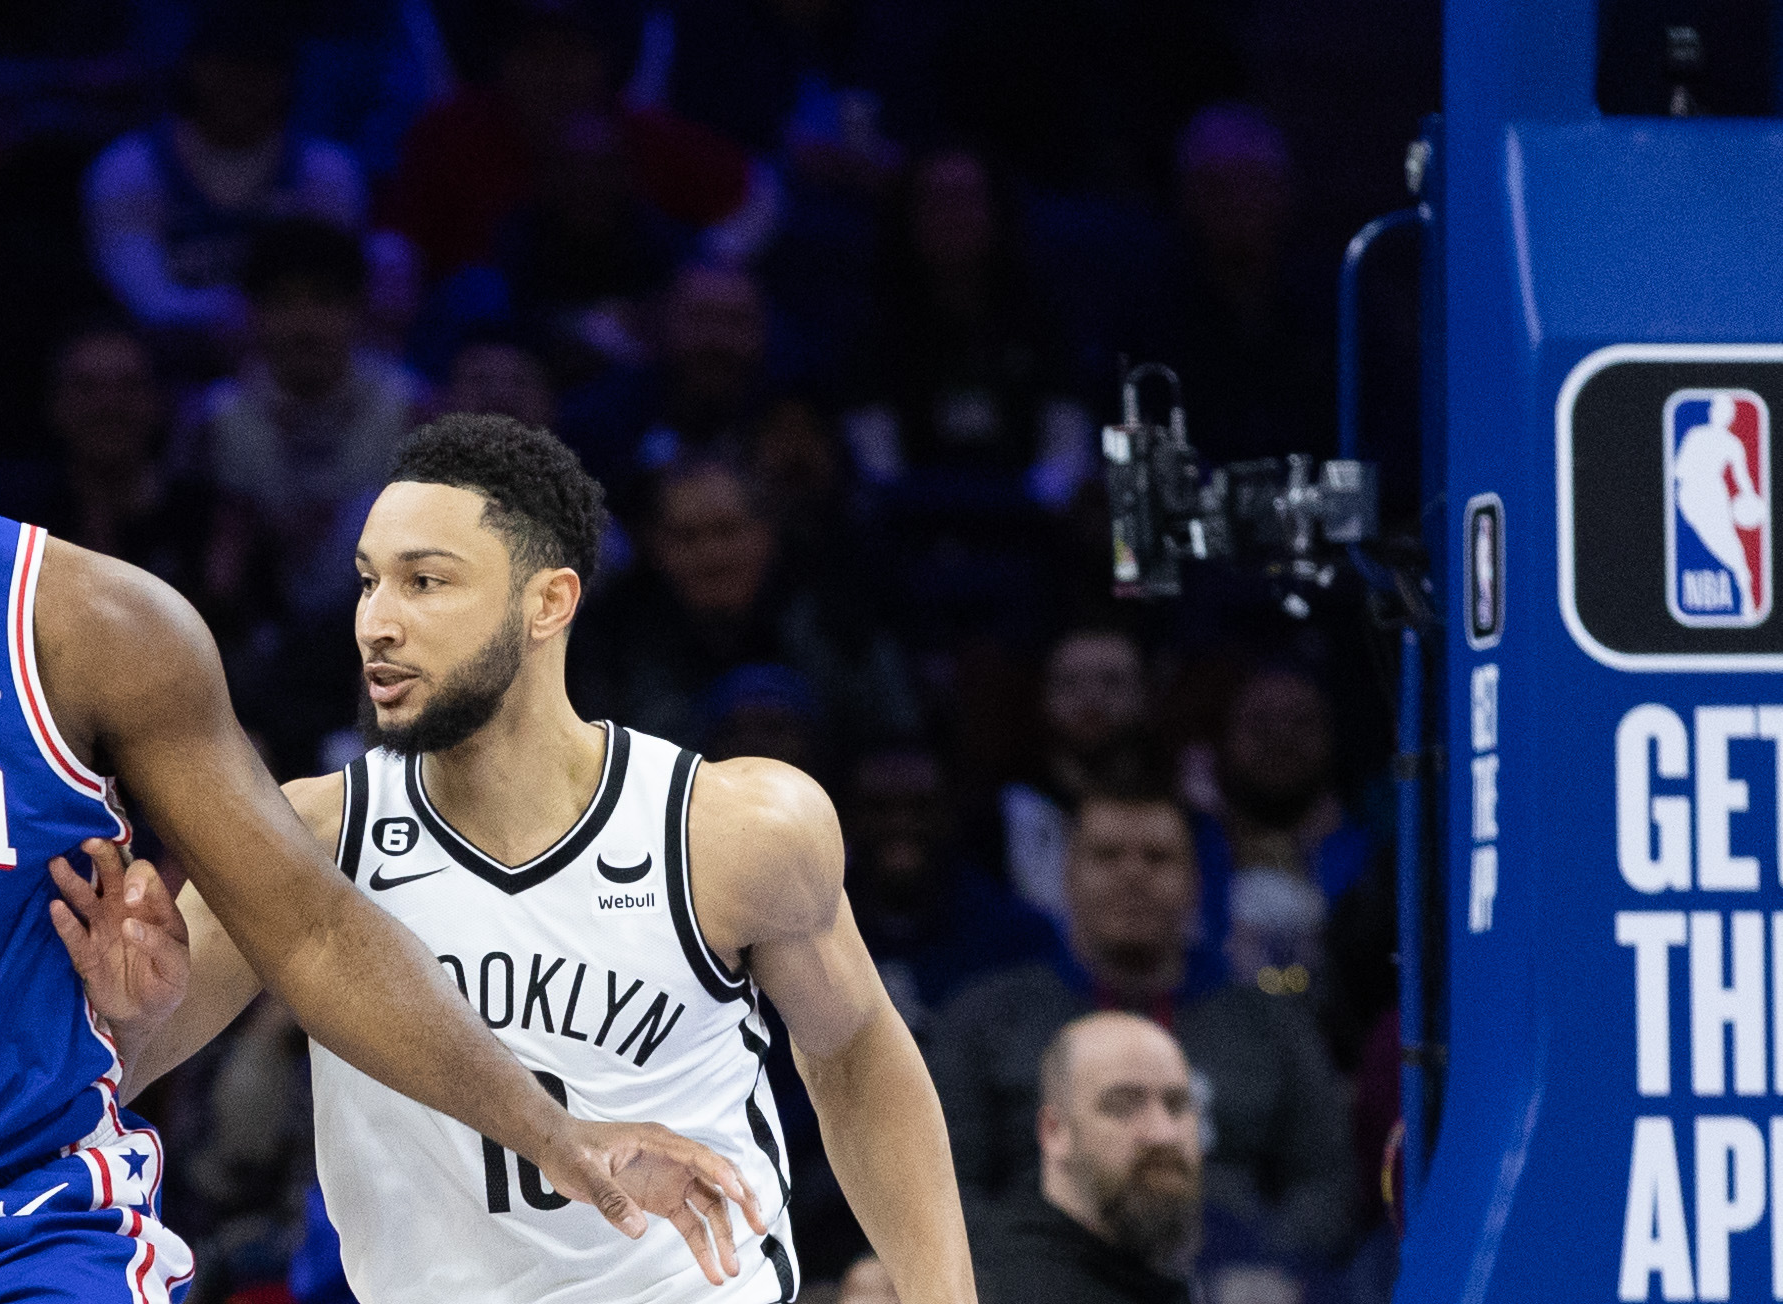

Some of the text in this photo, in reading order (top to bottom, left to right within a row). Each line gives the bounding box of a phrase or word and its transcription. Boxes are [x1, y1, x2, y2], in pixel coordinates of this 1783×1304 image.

[1683, 569, 1734, 610] NBA
[382, 823, 410, 852] 6
[598, 893, 656, 910] Webull
[437, 951, 686, 1067] OKLYN
[1614, 911, 1783, 1096] TH
[1617, 1116, 1783, 1302] AP
